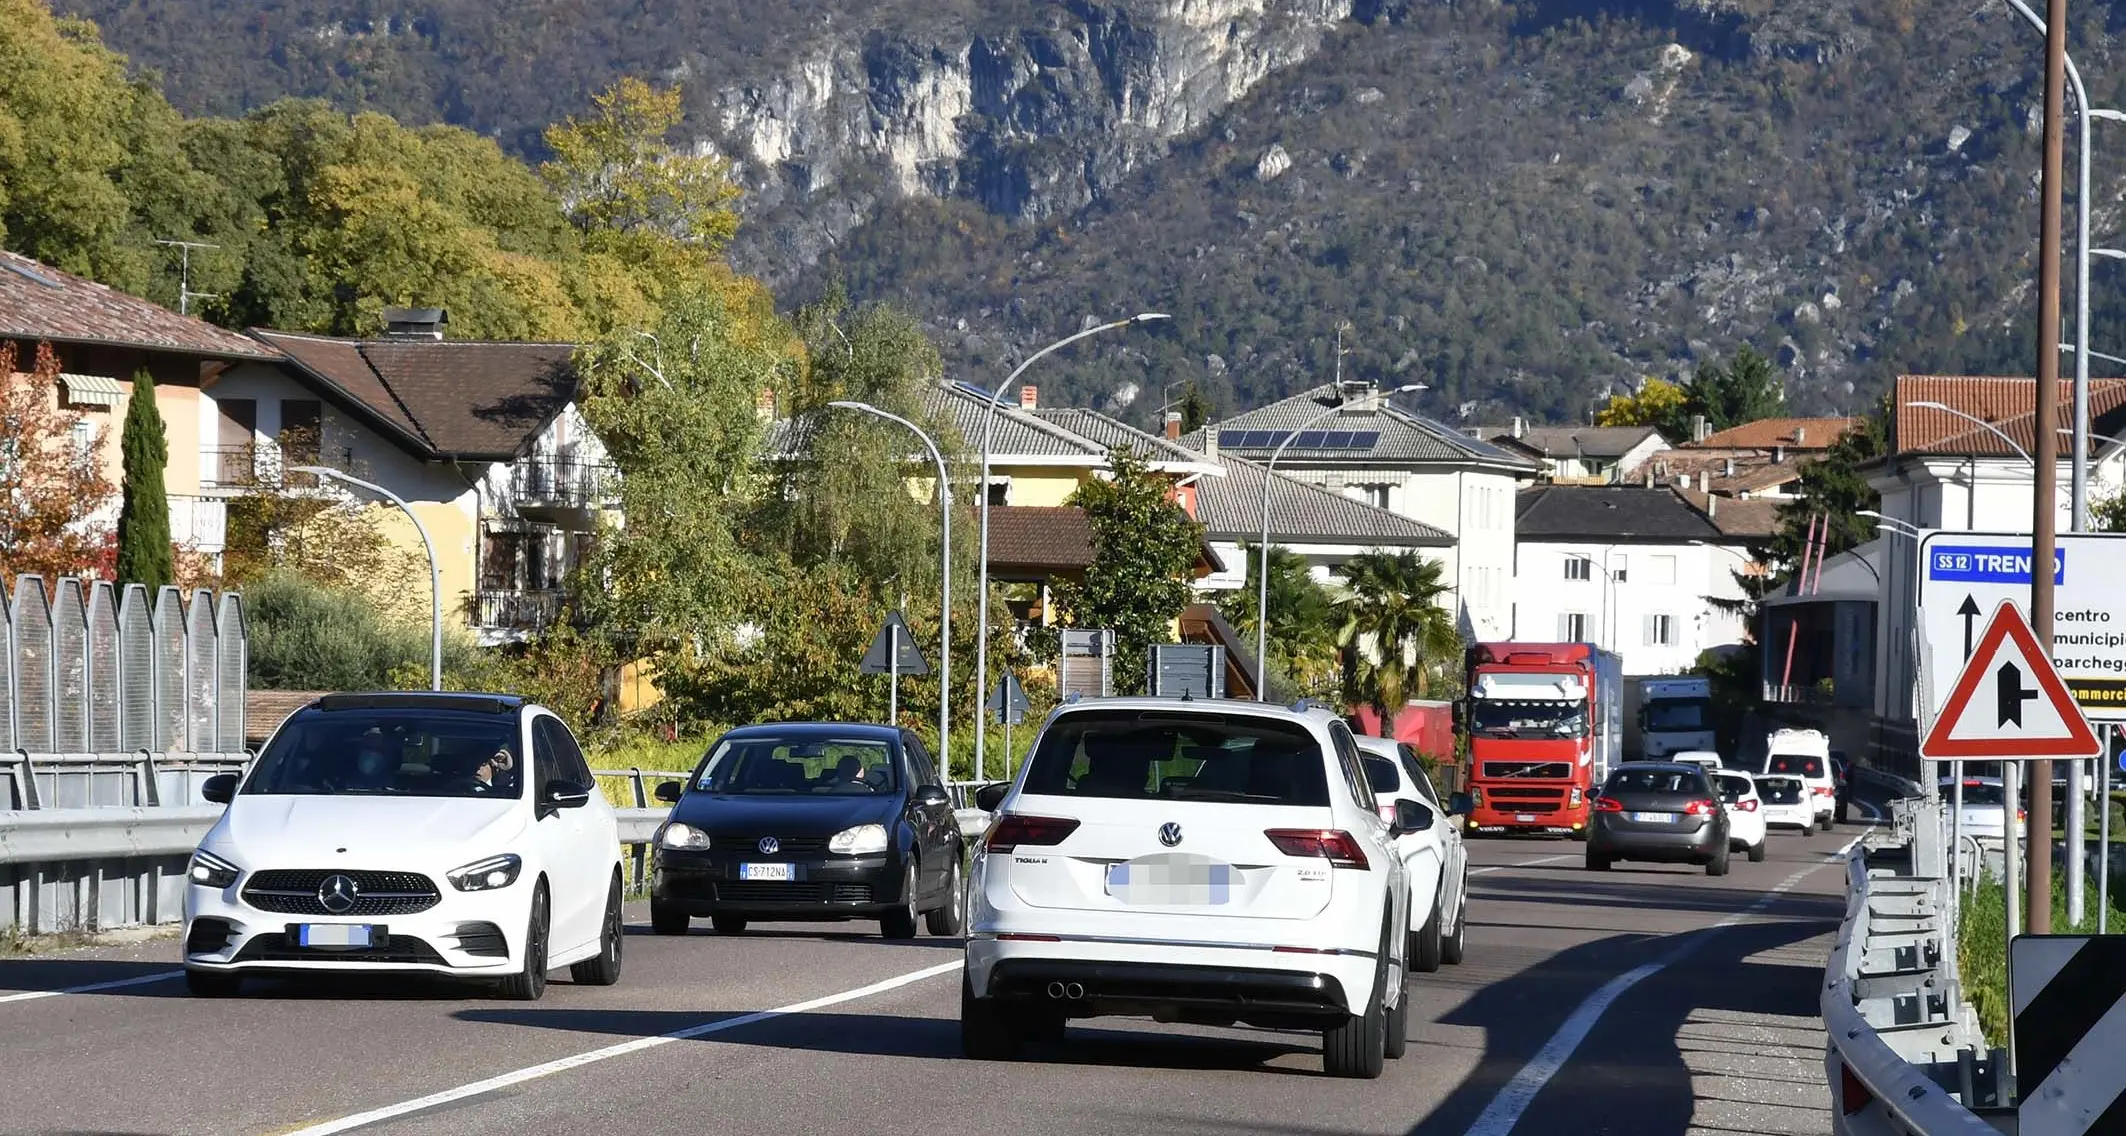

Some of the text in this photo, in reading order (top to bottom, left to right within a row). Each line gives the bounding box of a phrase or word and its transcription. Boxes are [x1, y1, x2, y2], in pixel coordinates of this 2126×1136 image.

[1940, 554, 2062, 574] SS 12 TREN
[2055, 609, 2110, 622] centro
[2054, 632, 2126, 648] municipi
[2054, 656, 2126, 672] parcheg
